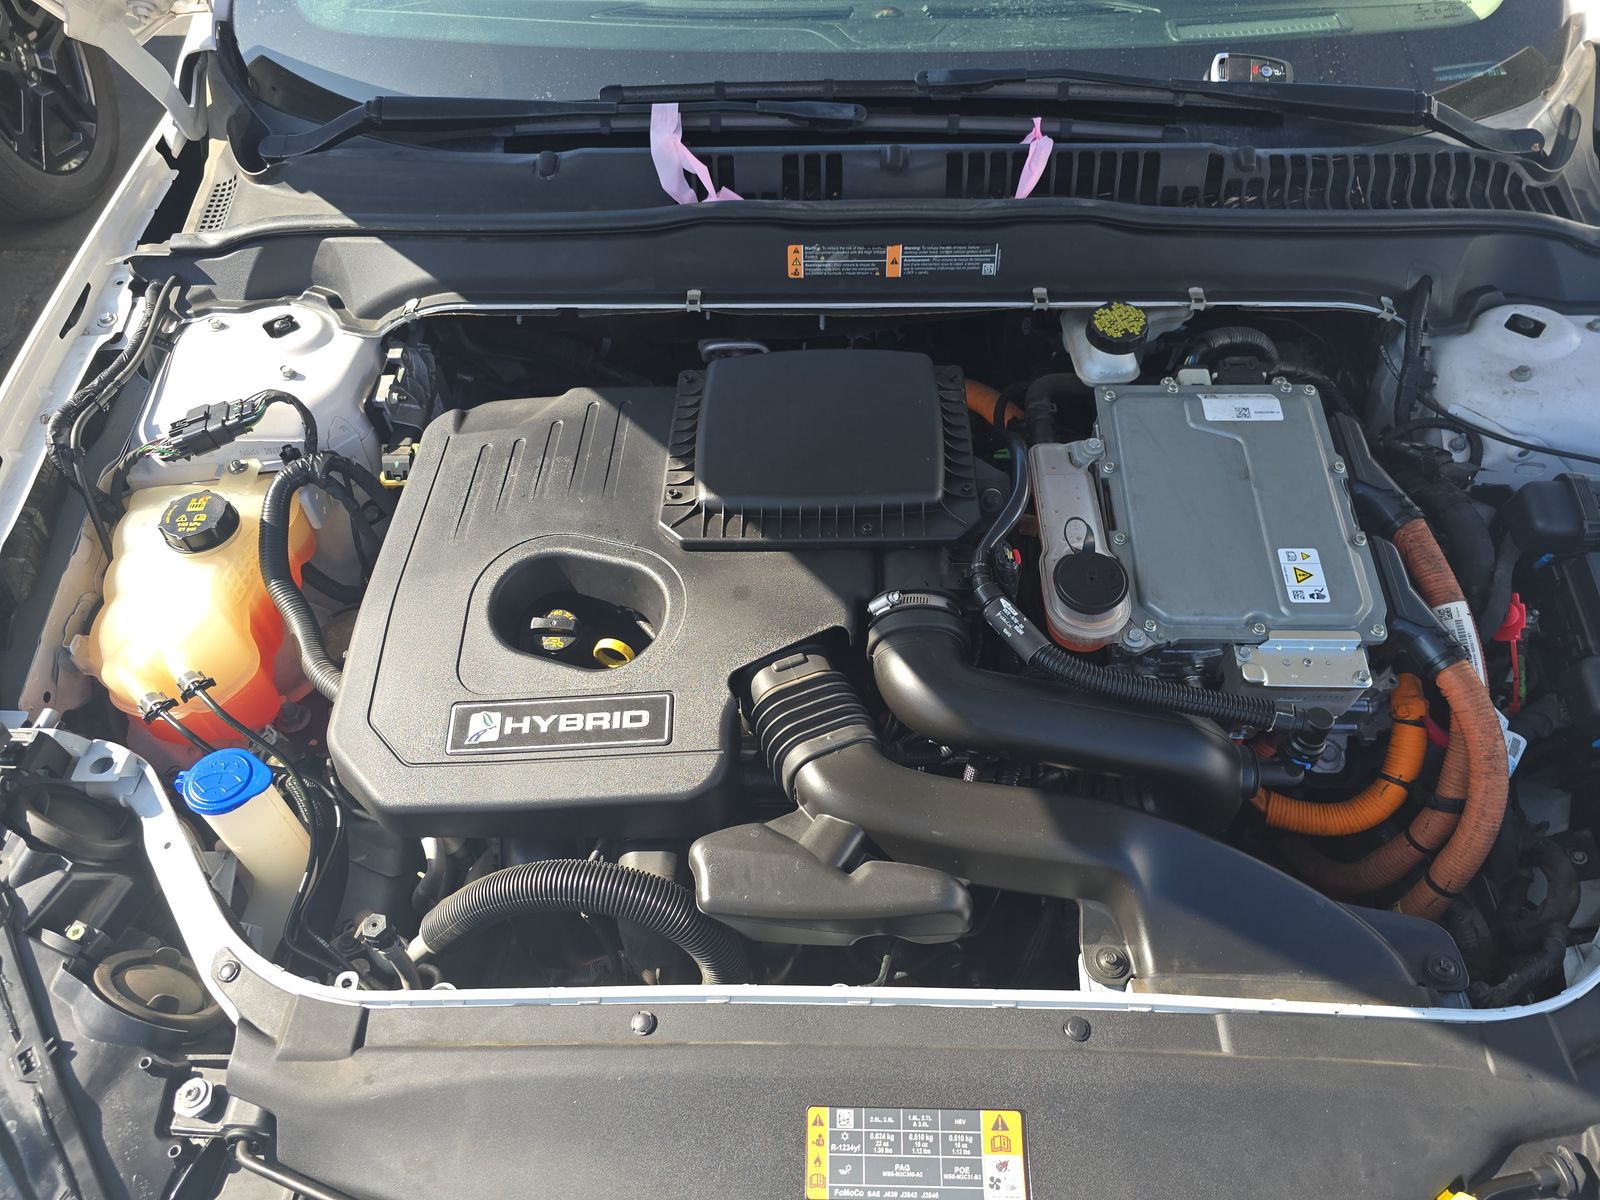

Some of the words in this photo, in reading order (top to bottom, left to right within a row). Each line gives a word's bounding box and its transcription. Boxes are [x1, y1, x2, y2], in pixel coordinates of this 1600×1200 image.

[504, 710, 650, 735] HYBRID
[887, 1133, 894, 1141] kg
[926, 1134, 933, 1142] kg
[965, 1135, 973, 1143] kg
[830, 1144, 861, 1153] R-1234yf
[834, 1189, 864, 1197] FoMoCo
